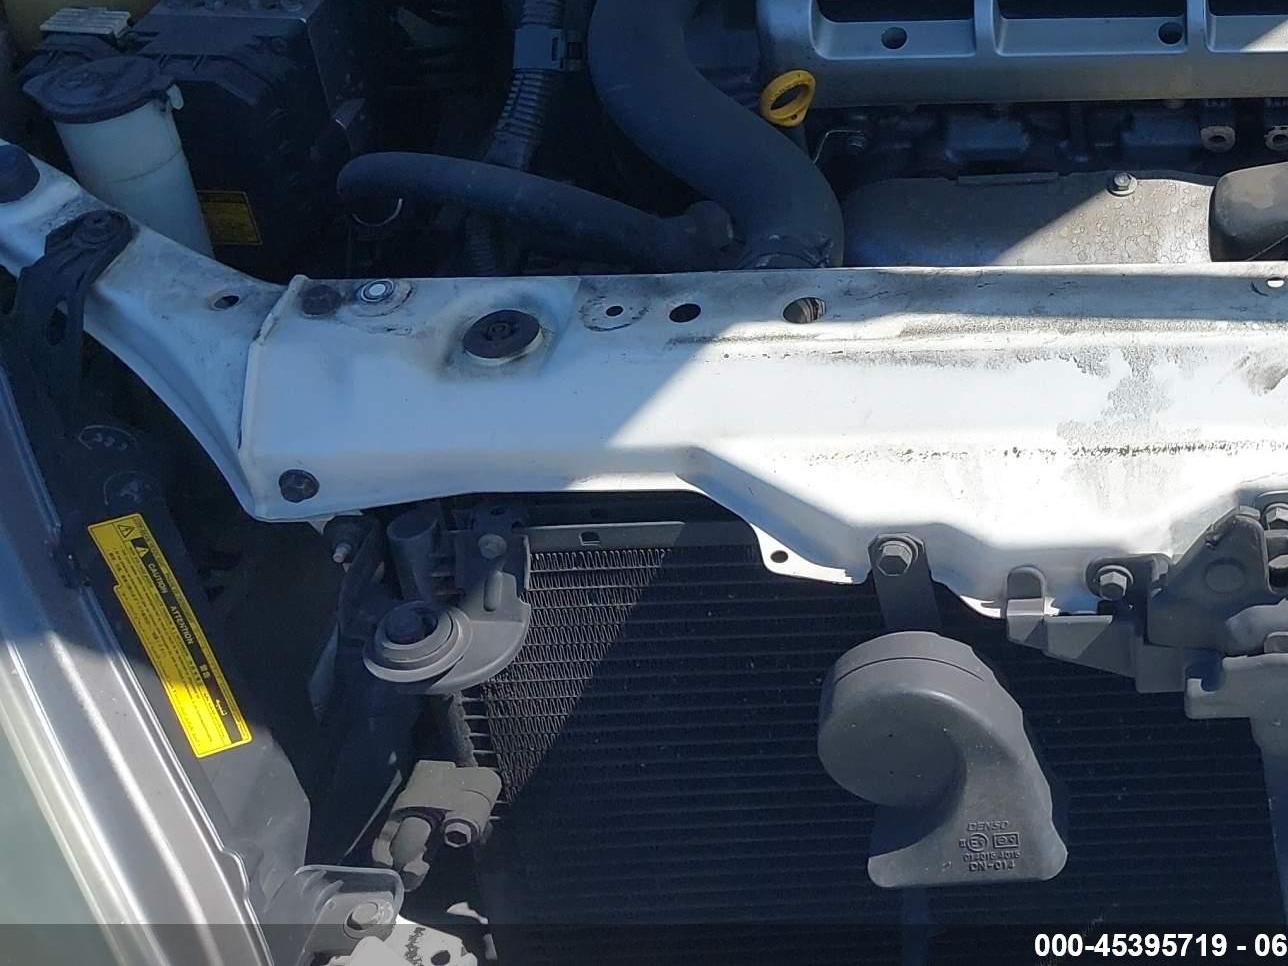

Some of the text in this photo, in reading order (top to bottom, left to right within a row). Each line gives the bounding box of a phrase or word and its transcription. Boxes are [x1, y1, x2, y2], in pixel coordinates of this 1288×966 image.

[148, 562, 194, 646] CAUTION ATTENTION
[967, 820, 1009, 832] DENSO
